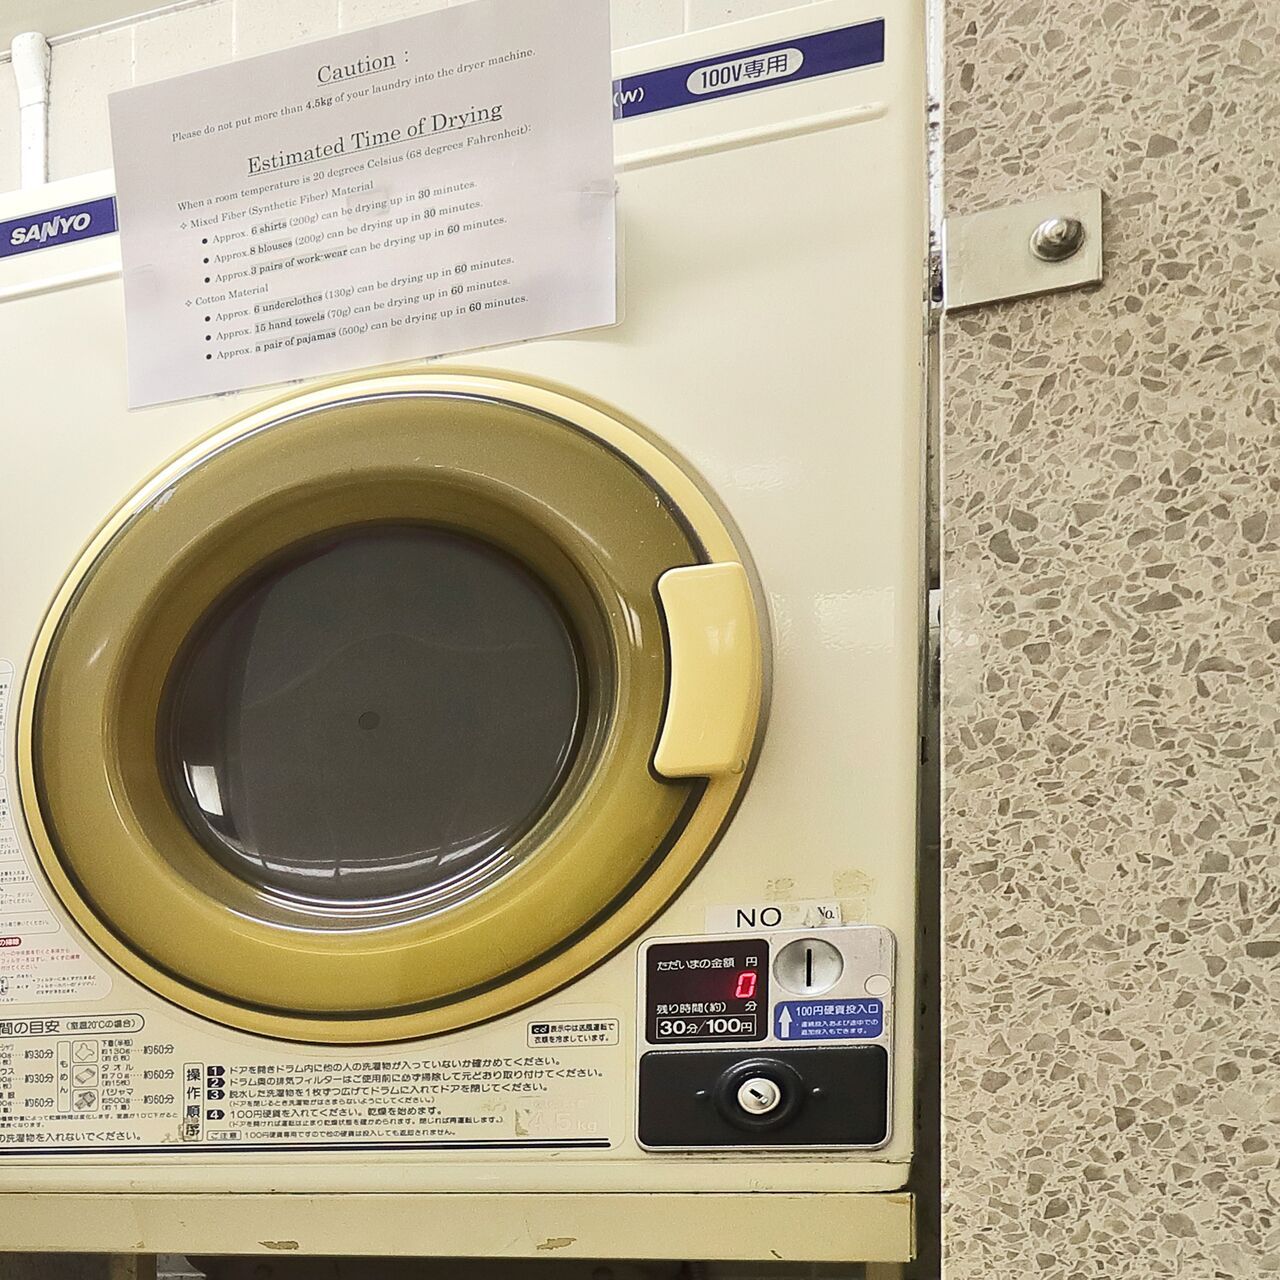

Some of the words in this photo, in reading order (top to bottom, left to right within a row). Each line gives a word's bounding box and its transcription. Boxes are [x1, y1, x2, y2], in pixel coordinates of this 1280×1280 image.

[317, 55, 396, 82] Caution
[701, 53, 788, 89] 100V専用
[172, 130, 201, 142] Please
[203, 125, 215, 134] do
[217, 121, 232, 131] not
[235, 116, 251, 128] put
[254, 111, 278, 122] more
[280, 105, 303, 116] than
[305, 96, 332, 109] 4.5kg
[334, 91, 345, 102] of
[346, 88, 369, 102] your
[371, 78, 411, 94] laundry
[414, 73, 434, 84] into
[437, 67, 454, 78] the
[456, 61, 485, 73] dryer
[488, 49, 535, 66] machine.
[248, 137, 344, 173] Estimated
[350, 129, 400, 149] Time
[407, 117, 426, 137] of
[431, 105, 502, 134] Drying
[177, 200, 204, 211] When
[215, 192, 238, 203] room
[240, 179, 299, 197] temperature
[302, 174, 310, 184] is
[312, 171, 324, 181] 20
[327, 164, 364, 177] degrees
[367, 155, 403, 168] Celsius
[405, 149, 422, 160] (68
[424, 142, 463, 156] degrees
[466, 124, 531, 146] Fahrenheit):
[190, 214, 218, 228] Mixed
[221, 210, 246, 221] Fiber
[248, 199, 297, 215] (Synthetic
[300, 190, 328, 204] Fiber)
[331, 180, 373, 197] Material
[212, 231, 248, 244] Approx.
[251, 226, 257, 235] 6
[259, 222, 287, 233] shirts
[289, 212, 319, 226] (200g)
[321, 211, 338, 220] can
[340, 207, 352, 215] be
[354, 200, 387, 212] drying
[390, 197, 402, 206] up
[405, 193, 415, 202] in
[418, 188, 430, 199] 30
[433, 181, 477, 196] minutes.
[10, 212, 91, 245] SANYO
[257, 240, 293, 253] blouses
[294, 232, 325, 245] (200g)
[326, 230, 344, 239] can
[346, 226, 358, 235] be
[360, 219, 393, 232] drying
[395, 216, 408, 225] up
[410, 212, 421, 222] in
[423, 208, 436, 219] 30
[438, 201, 483, 215] minutes.
[259, 262, 283, 275] pairs
[284, 257, 294, 268] of
[349, 245, 367, 255] can
[369, 241, 381, 250] be
[383, 235, 416, 247] drying
[418, 232, 431, 241] up
[434, 229, 444, 237] in
[447, 224, 460, 234] 60
[462, 217, 507, 231] minutes.
[195, 294, 226, 305] Cotton
[228, 283, 268, 299] Material
[215, 309, 250, 321] Approx.
[253, 305, 260, 313] 6
[262, 294, 322, 311] underclothes
[324, 286, 355, 299] (130g)
[357, 284, 374, 293] can
[376, 280, 388, 289] be
[390, 274, 423, 286] drying
[426, 271, 438, 280] up
[441, 268, 451, 277] in
[454, 263, 467, 274] 60
[470, 257, 514, 271] minutes.
[216, 328, 251, 341] Approx.
[255, 323, 265, 333] 15
[267, 317, 292, 330] hand
[294, 312, 325, 325] towels
[327, 306, 351, 318] (70g)
[353, 305, 370, 314] can
[373, 301, 384, 310] be
[387, 295, 419, 307] drying
[422, 293, 435, 301] up
[438, 288, 448, 298] in
[450, 285, 463, 295] 60
[466, 279, 510, 292] minutes.
[217, 348, 252, 359] Approx.
[263, 339, 283, 352] pair
[284, 336, 294, 346] of
[296, 331, 336, 346] pajamas
[338, 322, 368, 336] (500g)
[370, 321, 388, 330] can
[390, 318, 402, 326] be
[404, 312, 437, 324] drying
[440, 309, 453, 318] up
[456, 305, 466, 314] in
[468, 301, 481, 312] 60
[484, 296, 528, 309] minutes.
[736, 907, 782, 928] NO
[657, 957, 735, 971] ただいまの金額
[745, 956, 758, 967] 円
[735, 972, 757, 998] 0
[744, 1000, 758, 1012] 分
[660, 1018, 753, 1035] 30分/100円
[795, 1003, 879, 1017] 100円硬貨投入口
